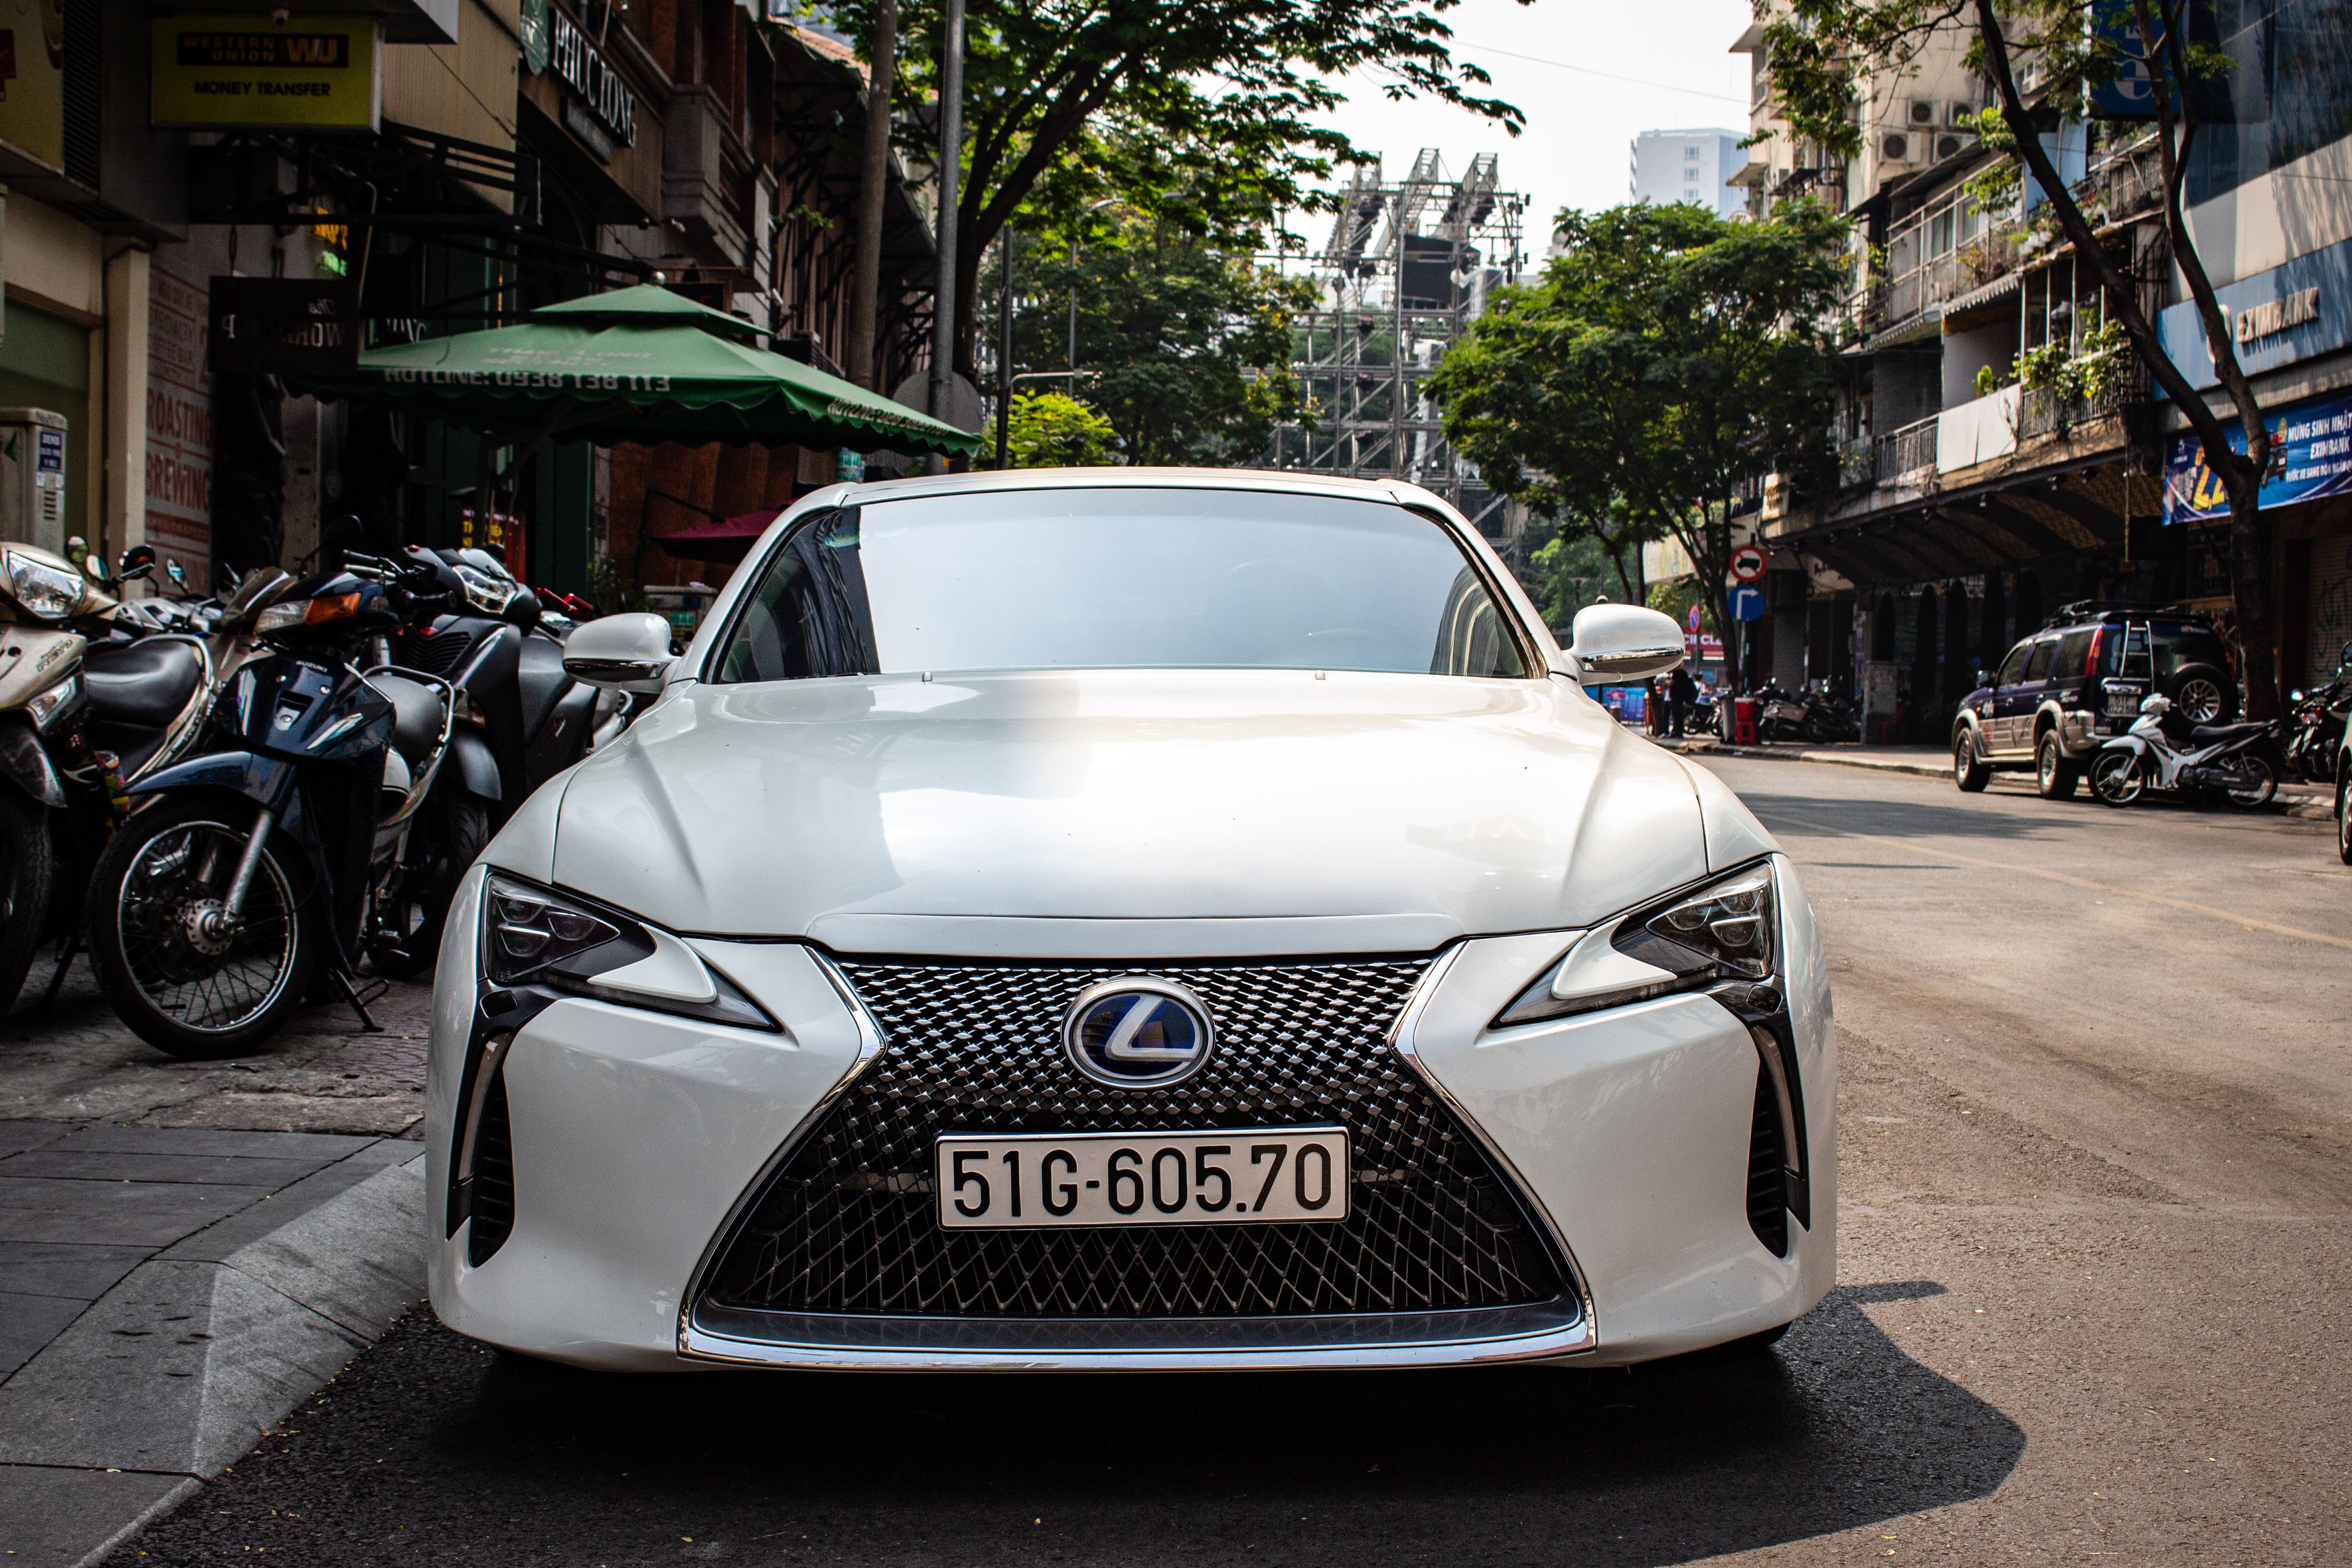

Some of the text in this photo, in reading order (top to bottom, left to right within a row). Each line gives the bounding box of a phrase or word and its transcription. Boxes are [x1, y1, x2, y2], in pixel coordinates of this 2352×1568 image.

[183, 36, 276, 48] WESTERN
[284, 37, 338, 63] WU
[211, 49, 276, 63] UNION
[194, 81, 331, 96] MONEY TRANSFER
[598, 60, 637, 147] LONG
[2236, 287, 2318, 343] EXIMBANK
[384, 367, 671, 392] HOTLINE: 0938 138 113
[2311, 418, 2330, 437] SINH
[2310, 436, 2350, 459] EXIMBANK
[147, 451, 212, 512] BREWING
[953, 1143, 1332, 1219] 51G-605.70
